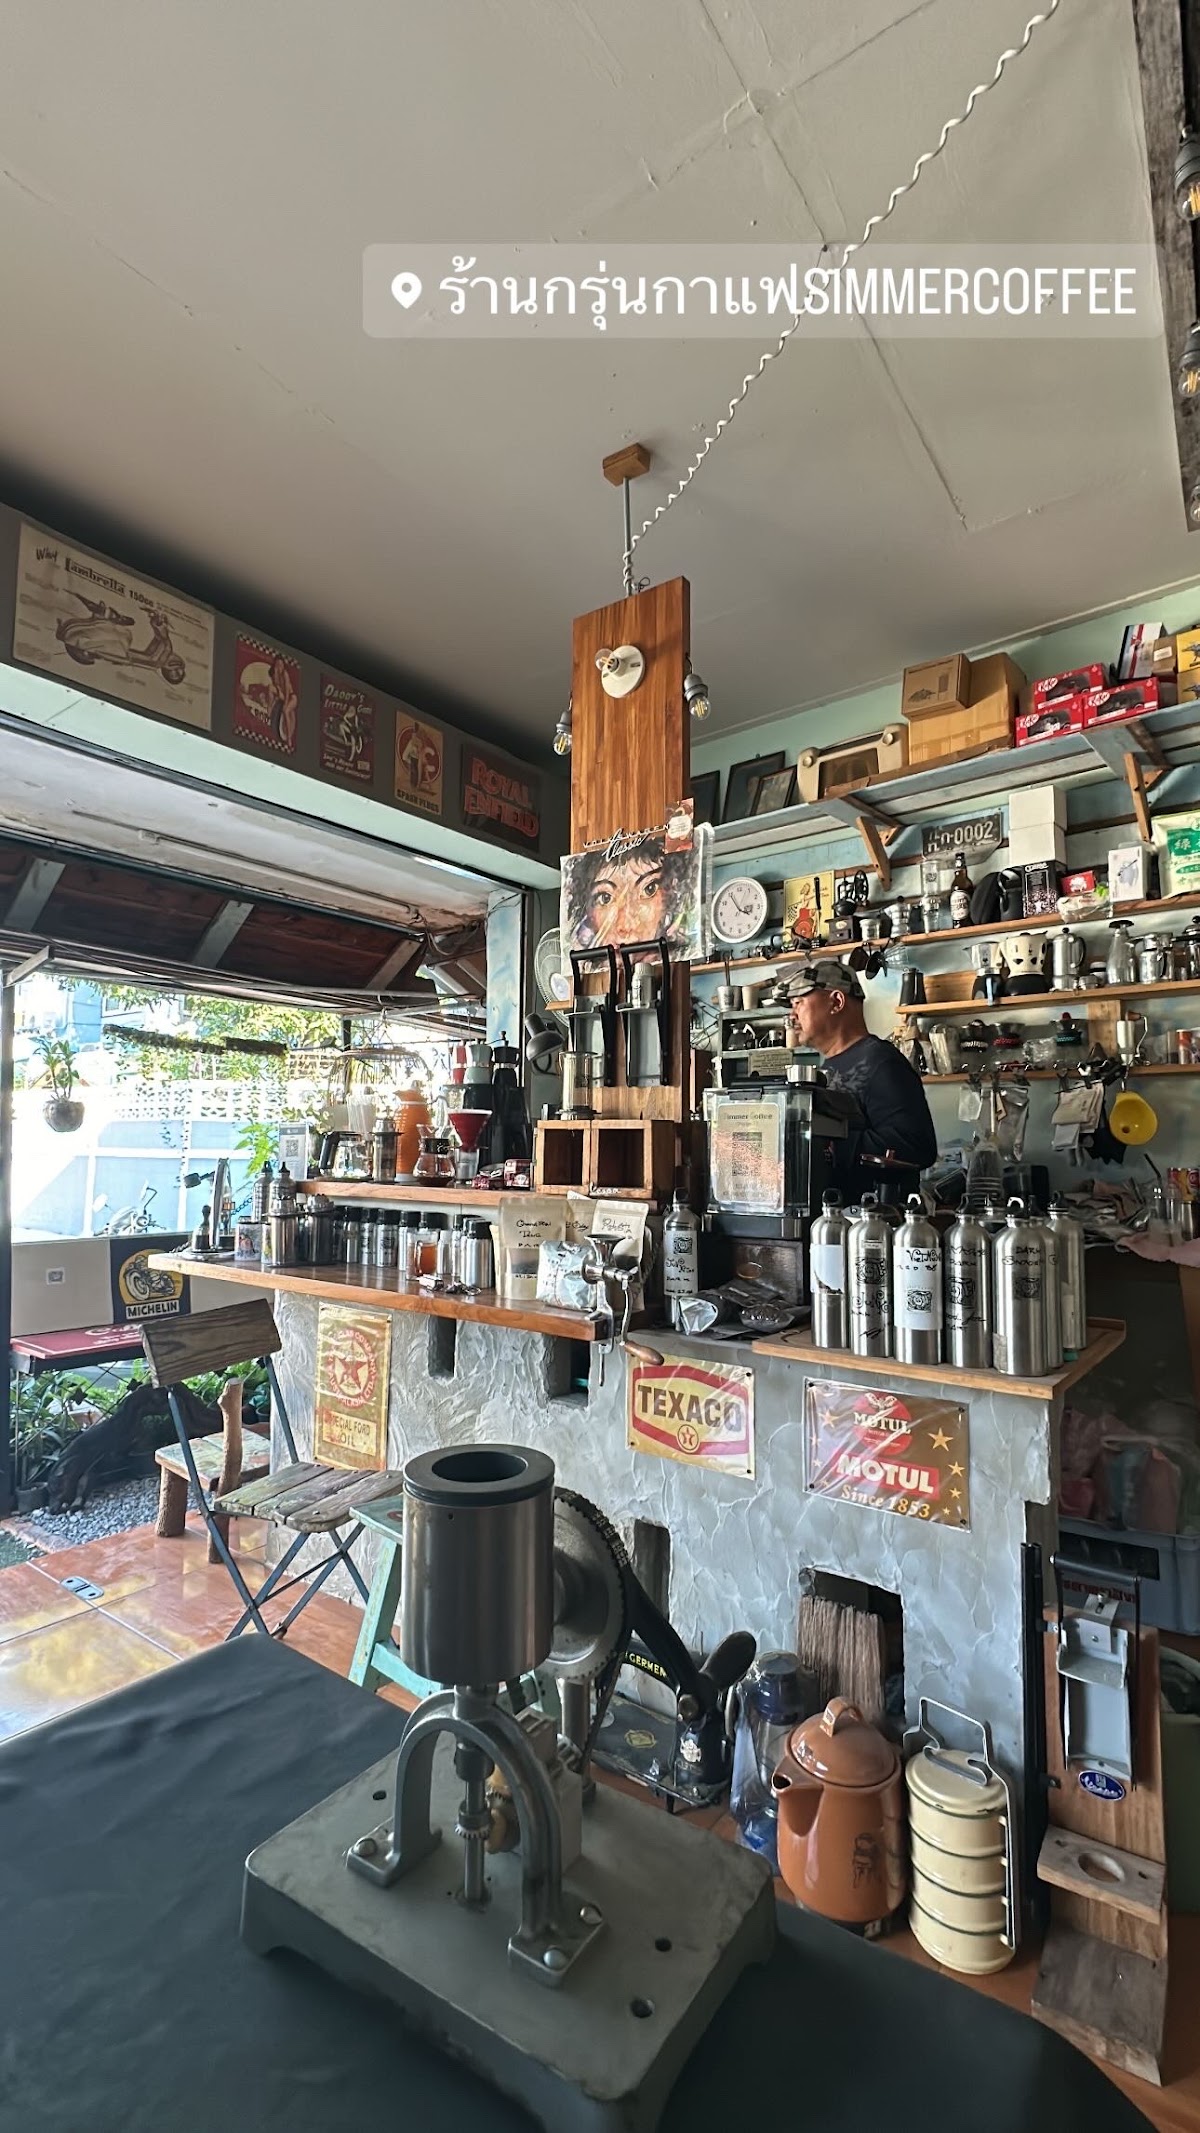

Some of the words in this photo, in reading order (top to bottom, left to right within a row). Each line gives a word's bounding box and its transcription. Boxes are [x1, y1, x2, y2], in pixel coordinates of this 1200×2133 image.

[471, 757, 529, 808] ROYAL
[464, 784, 539, 838] ENFIELD
[127, 1301, 178, 1318] MICHELIN
[326, 1413, 353, 1432] PECIAL
[353, 1422, 371, 1436] FORD
[637, 1384, 743, 1432] TEXACO
[853, 1412, 912, 1435] MOTUL
[340, 1429, 356, 1447] OIL
[837, 1453, 934, 1494] MOTUL
[841, 1484, 885, 1508] Since
[888, 1496, 931, 1518] 1853
